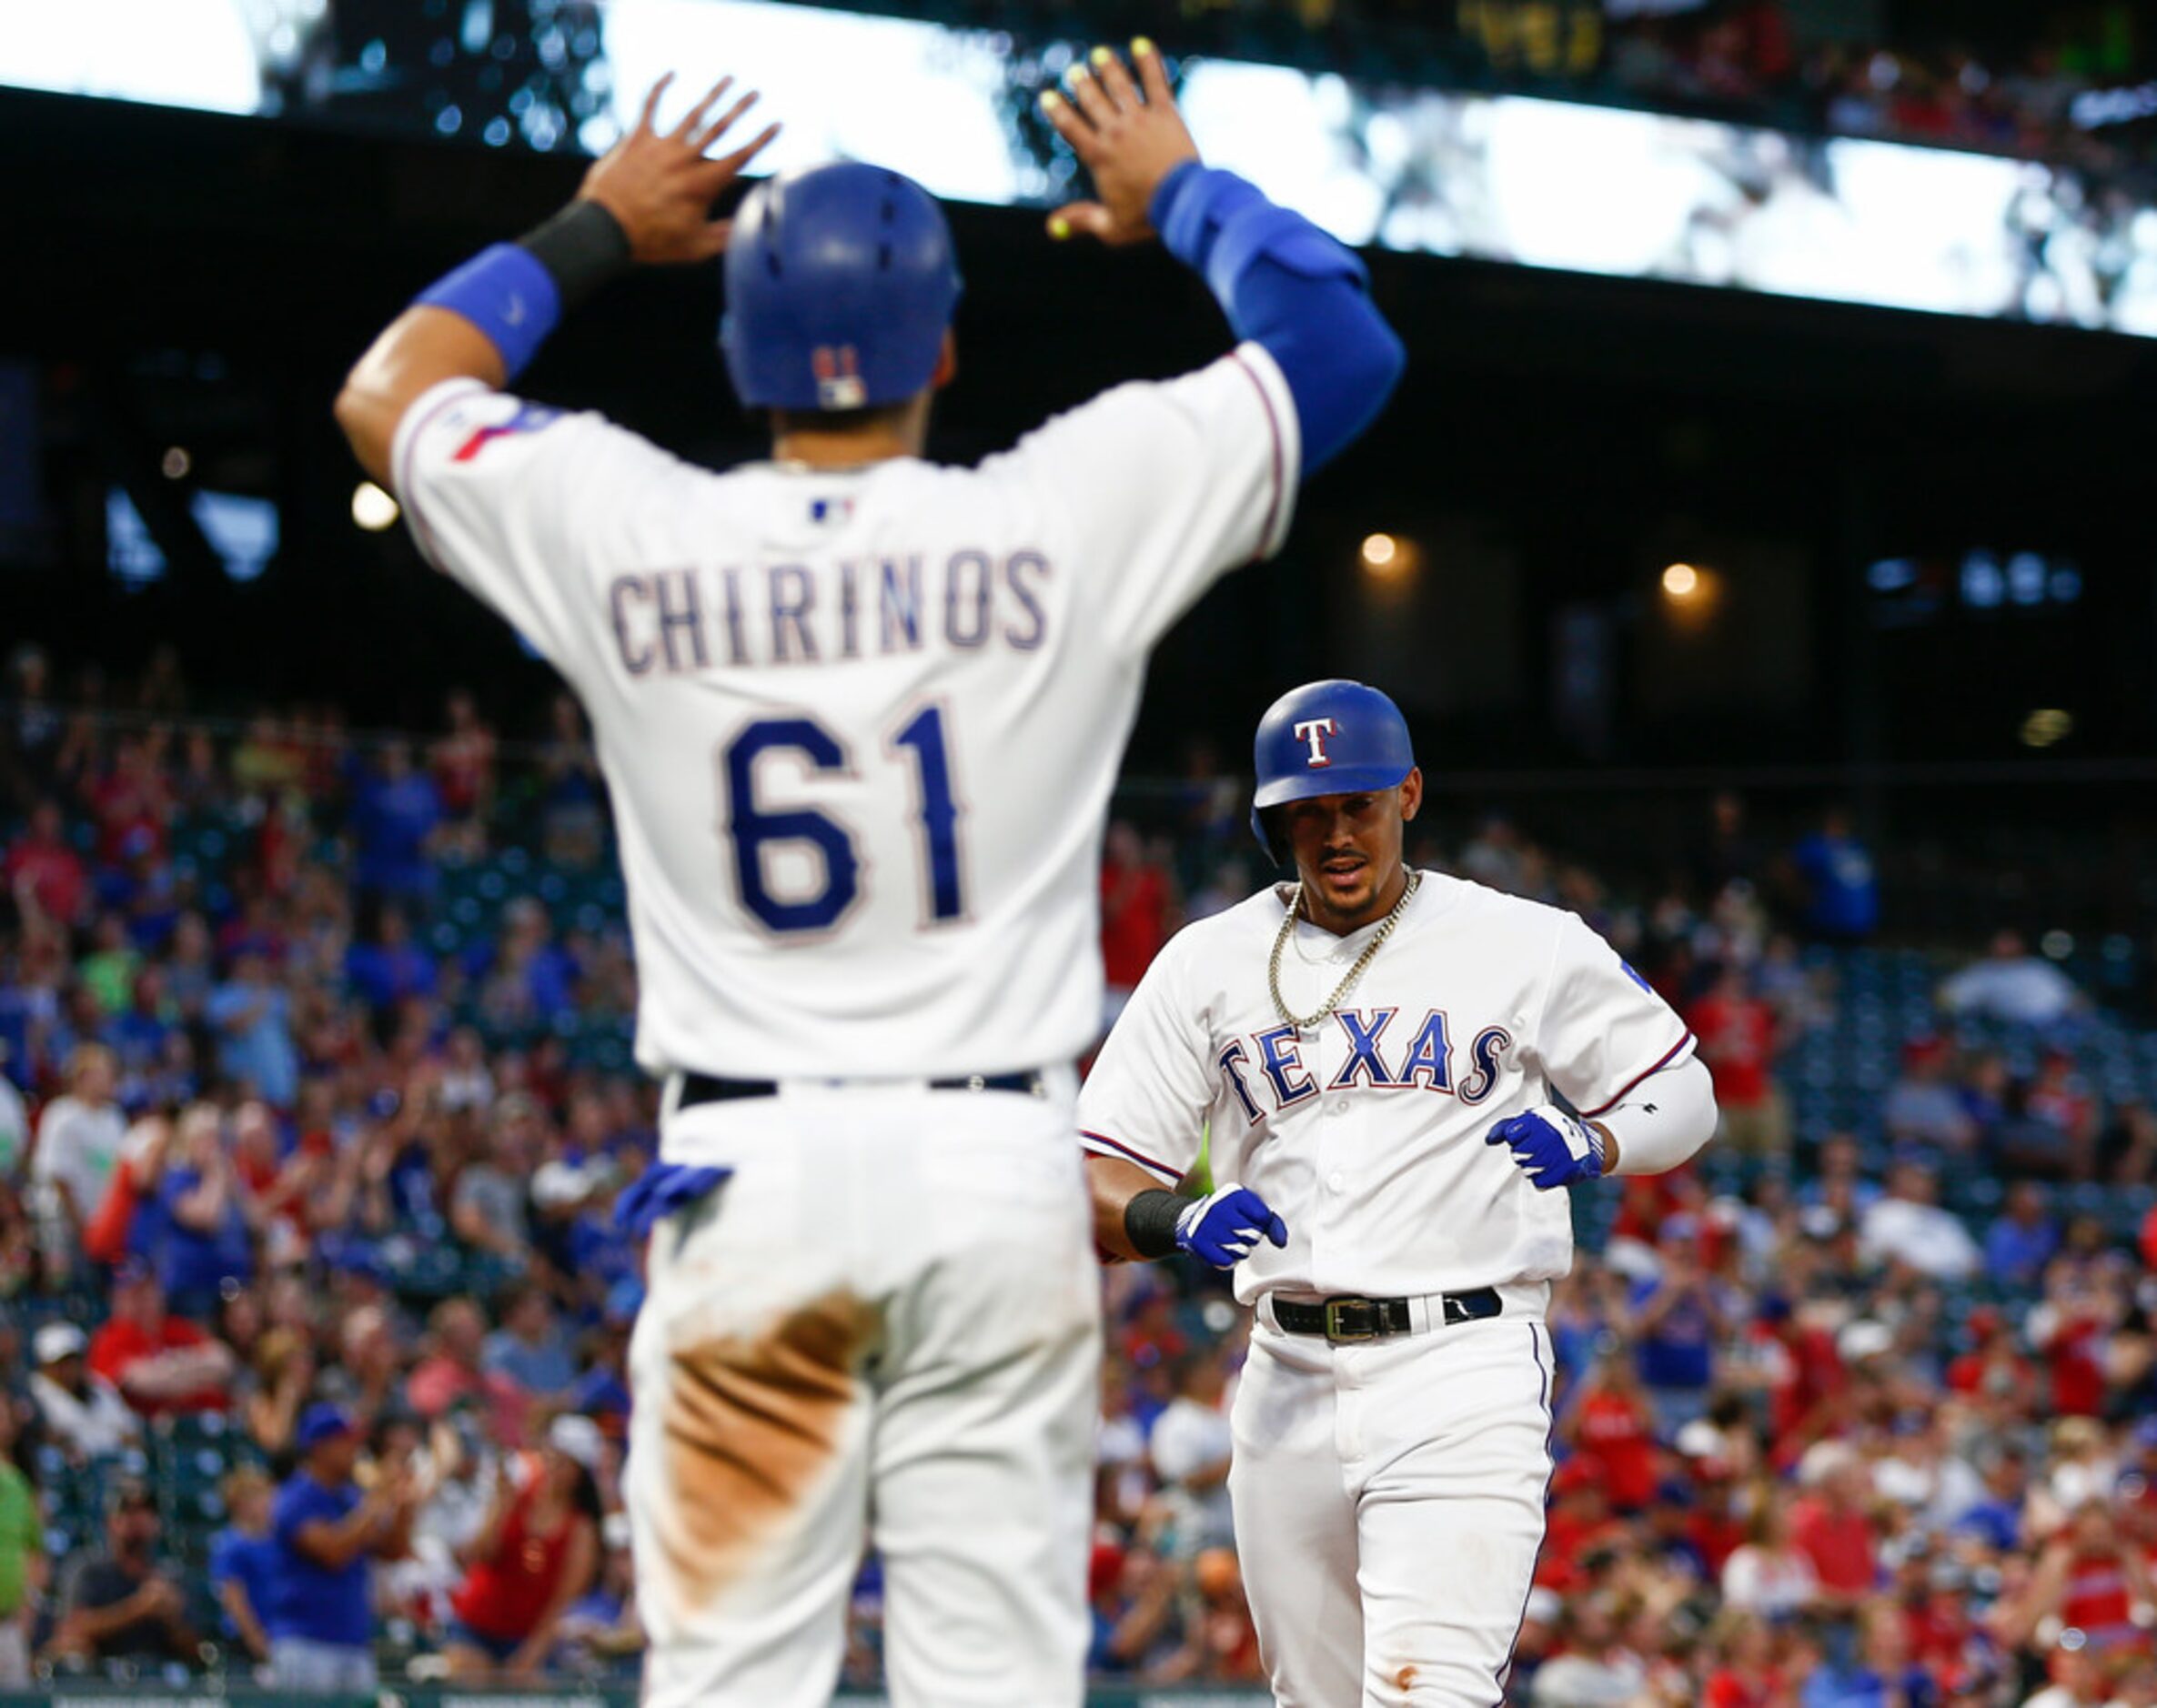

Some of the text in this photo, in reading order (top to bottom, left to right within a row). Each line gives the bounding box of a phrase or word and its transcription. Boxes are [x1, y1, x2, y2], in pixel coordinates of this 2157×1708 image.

[609, 549, 1052, 677] CHIRINOS
[1295, 718, 1336, 769] T
[717, 697, 977, 944] 61
[1219, 1007, 1512, 1126] TEXAS
